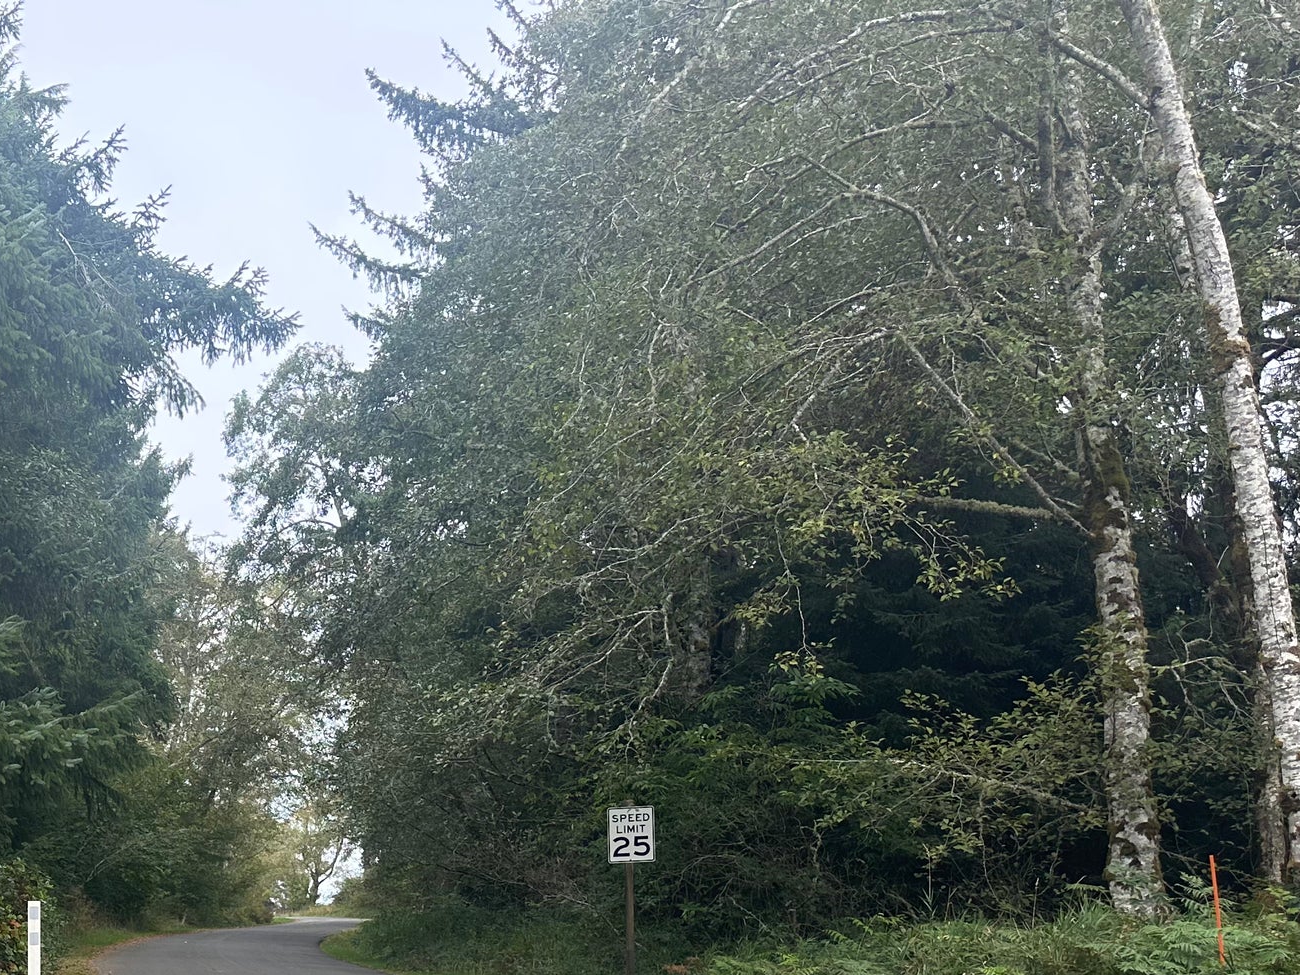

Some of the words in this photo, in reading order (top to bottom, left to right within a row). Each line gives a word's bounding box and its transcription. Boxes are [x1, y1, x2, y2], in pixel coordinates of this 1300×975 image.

[612, 812, 650, 823] SPEED
[616, 824, 646, 834] LIMIT
[612, 835, 651, 858] 25
